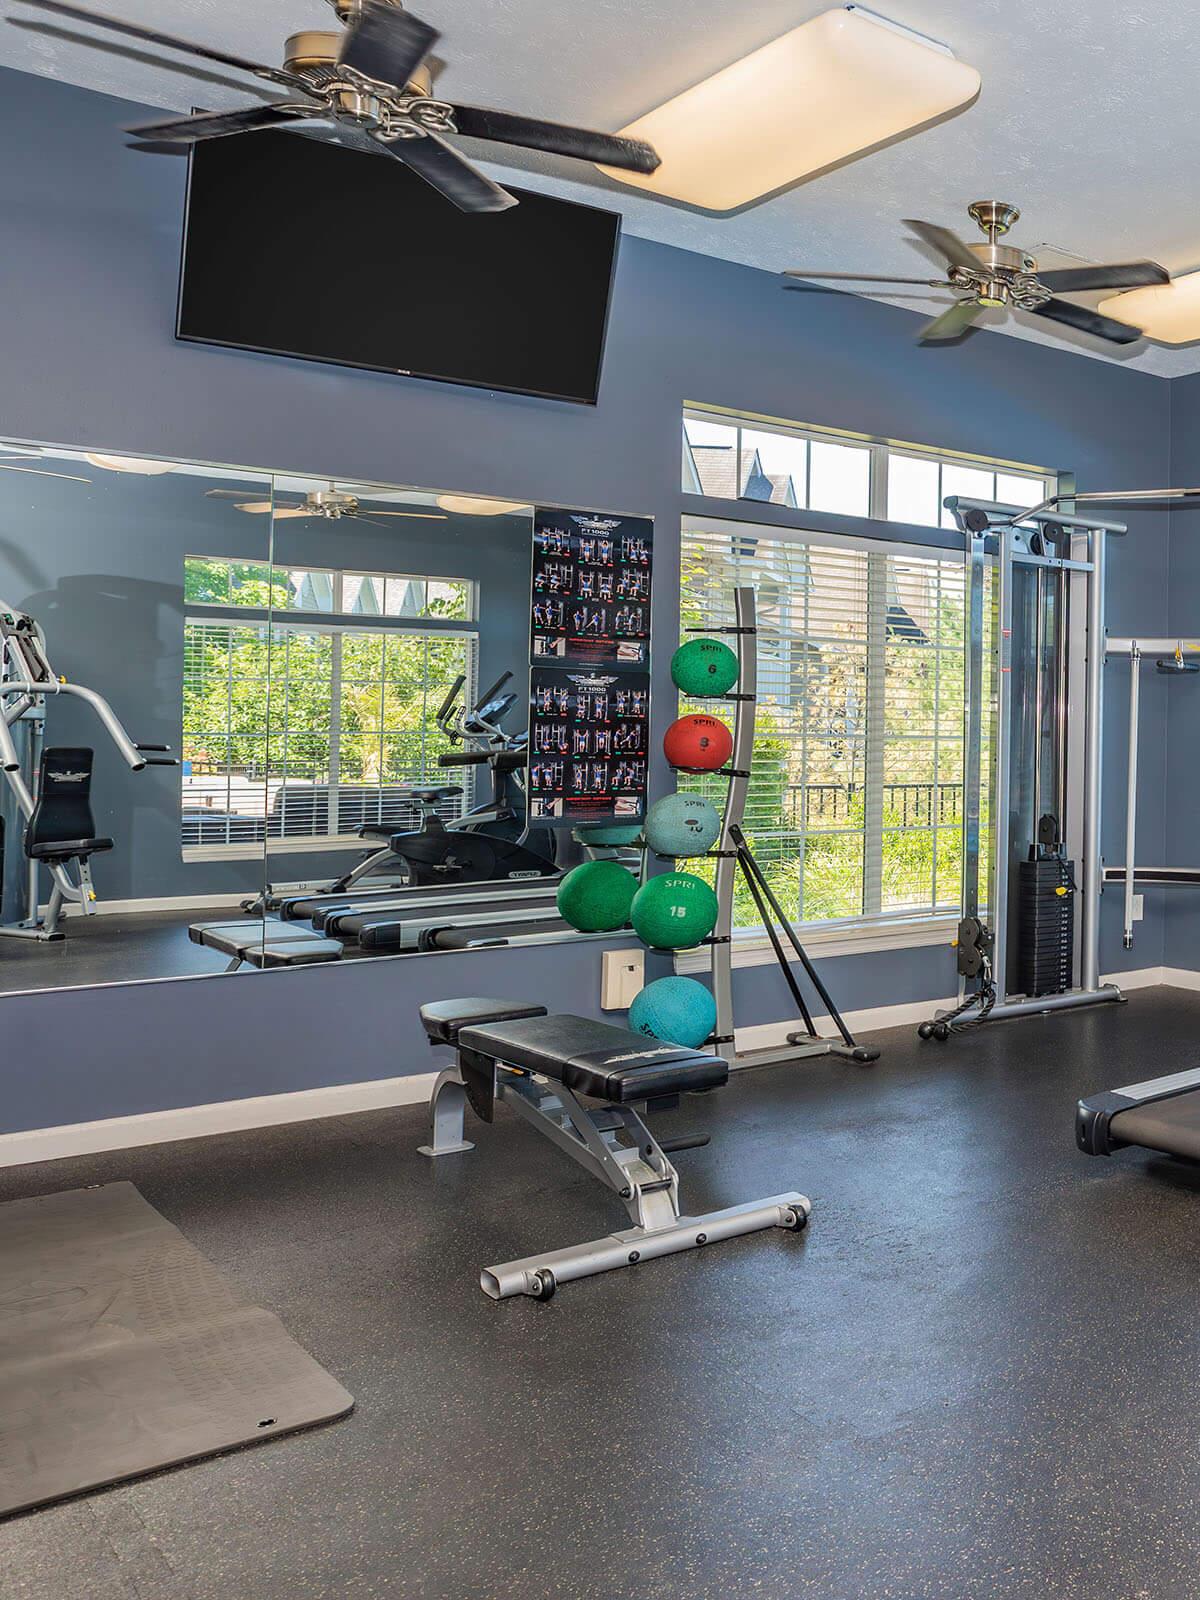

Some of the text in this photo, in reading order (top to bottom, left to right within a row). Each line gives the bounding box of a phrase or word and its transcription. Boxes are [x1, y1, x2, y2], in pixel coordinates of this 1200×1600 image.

[708, 664, 717, 674] 6
[664, 879, 696, 889] SPRI
[670, 905, 687, 918] 15
